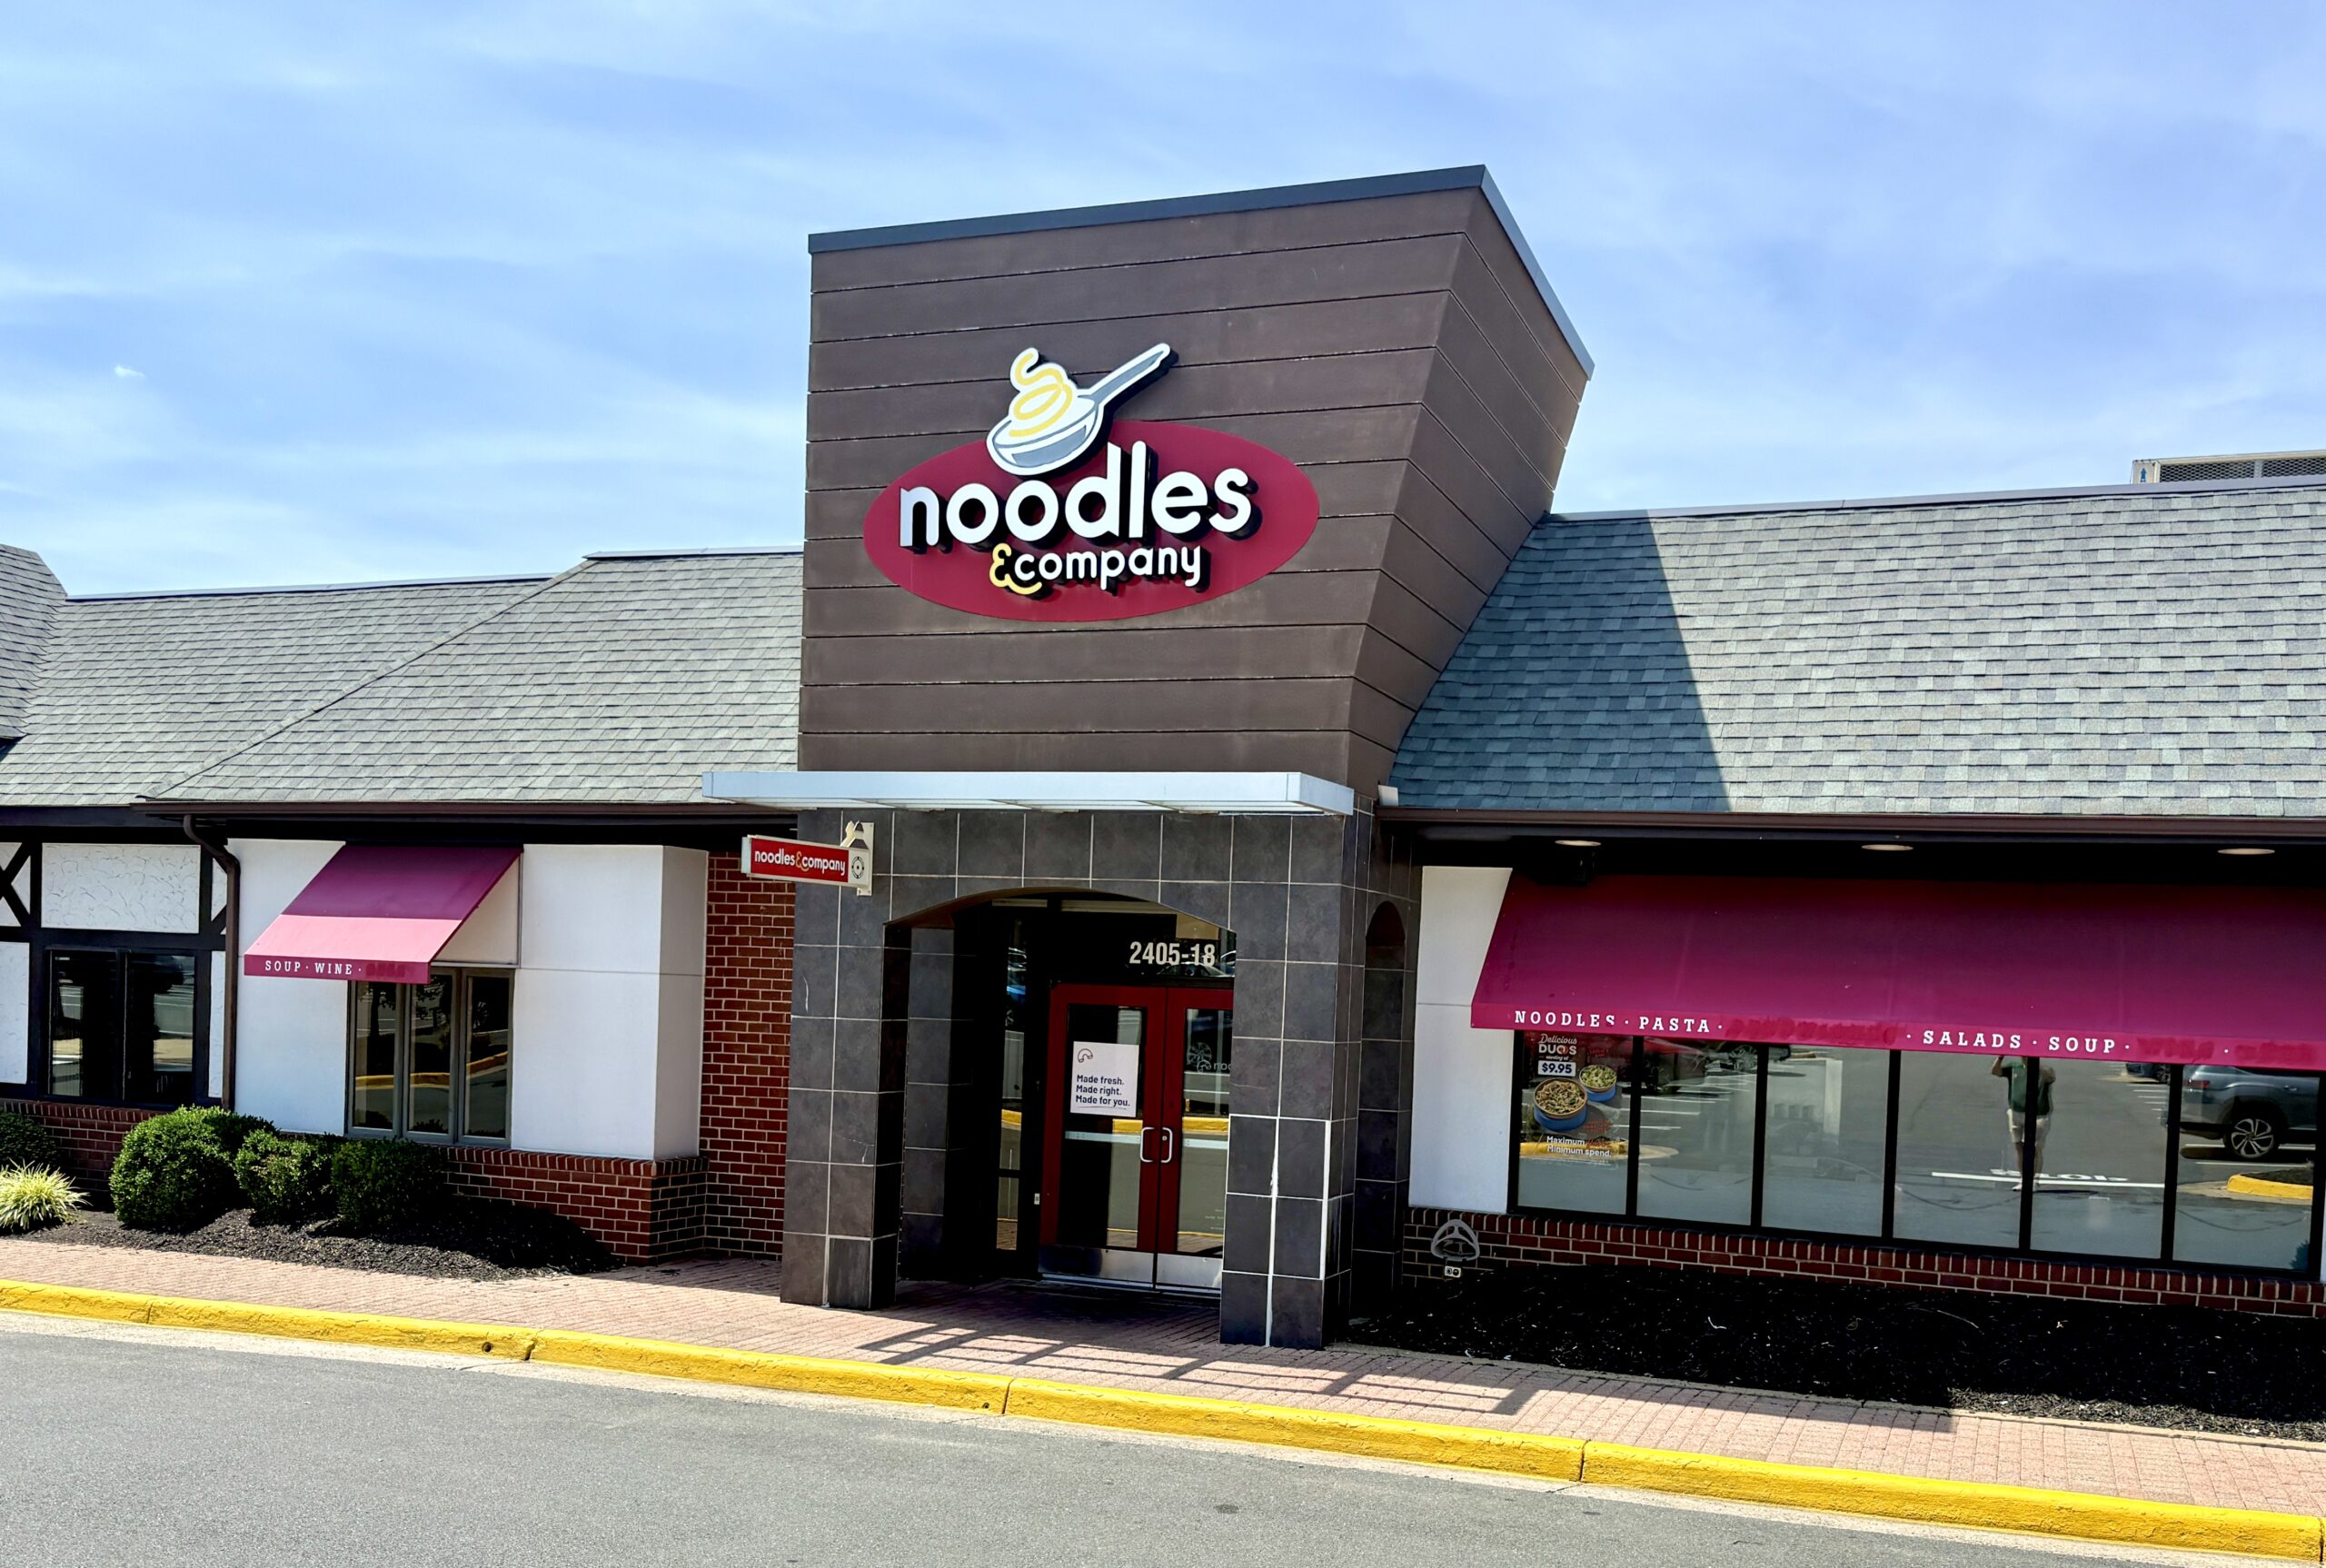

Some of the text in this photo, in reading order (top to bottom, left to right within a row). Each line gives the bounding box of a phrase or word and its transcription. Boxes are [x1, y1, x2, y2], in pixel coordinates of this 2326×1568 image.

[900, 440, 1252, 547] noodles
[1129, 941, 1216, 968] 2405-18
[265, 960, 353, 975] SOUP WINE
[1515, 1010, 1710, 1033] NOODLES PASTA
[1538, 1033, 1577, 1045] Delicious
[1923, 1030, 2115, 1053] SALADS SOUP
[1538, 1044, 1577, 1056] DUOS
[1541, 1062, 1572, 1074] $9.95
[1077, 1074, 1125, 1086] Made fresh.
[1076, 1085, 1122, 1097] Made right.
[1075, 1095, 1130, 1107] Made for you.
[1546, 1136, 1585, 1146] Maximum
[1547, 1146, 1584, 1155] Minimum
